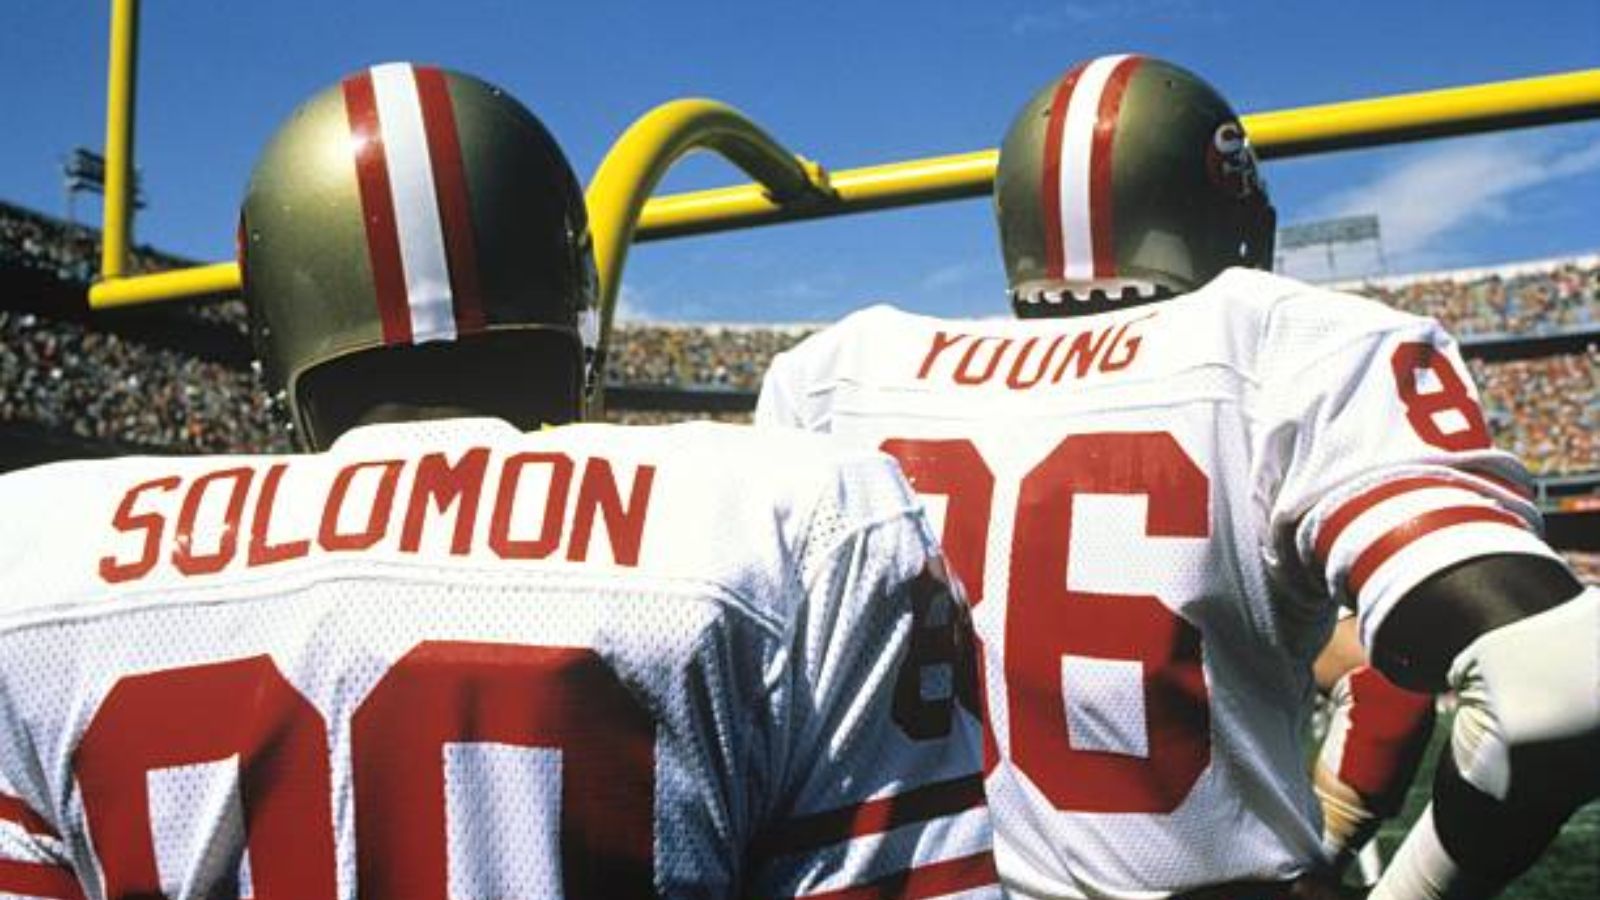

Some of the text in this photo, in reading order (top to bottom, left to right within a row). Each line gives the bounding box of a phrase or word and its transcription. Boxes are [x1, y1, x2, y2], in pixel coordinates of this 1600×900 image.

[916, 312, 1157, 390] YOUNG
[1391, 342, 1493, 452] 8
[99, 447, 656, 583] SOLOMON
